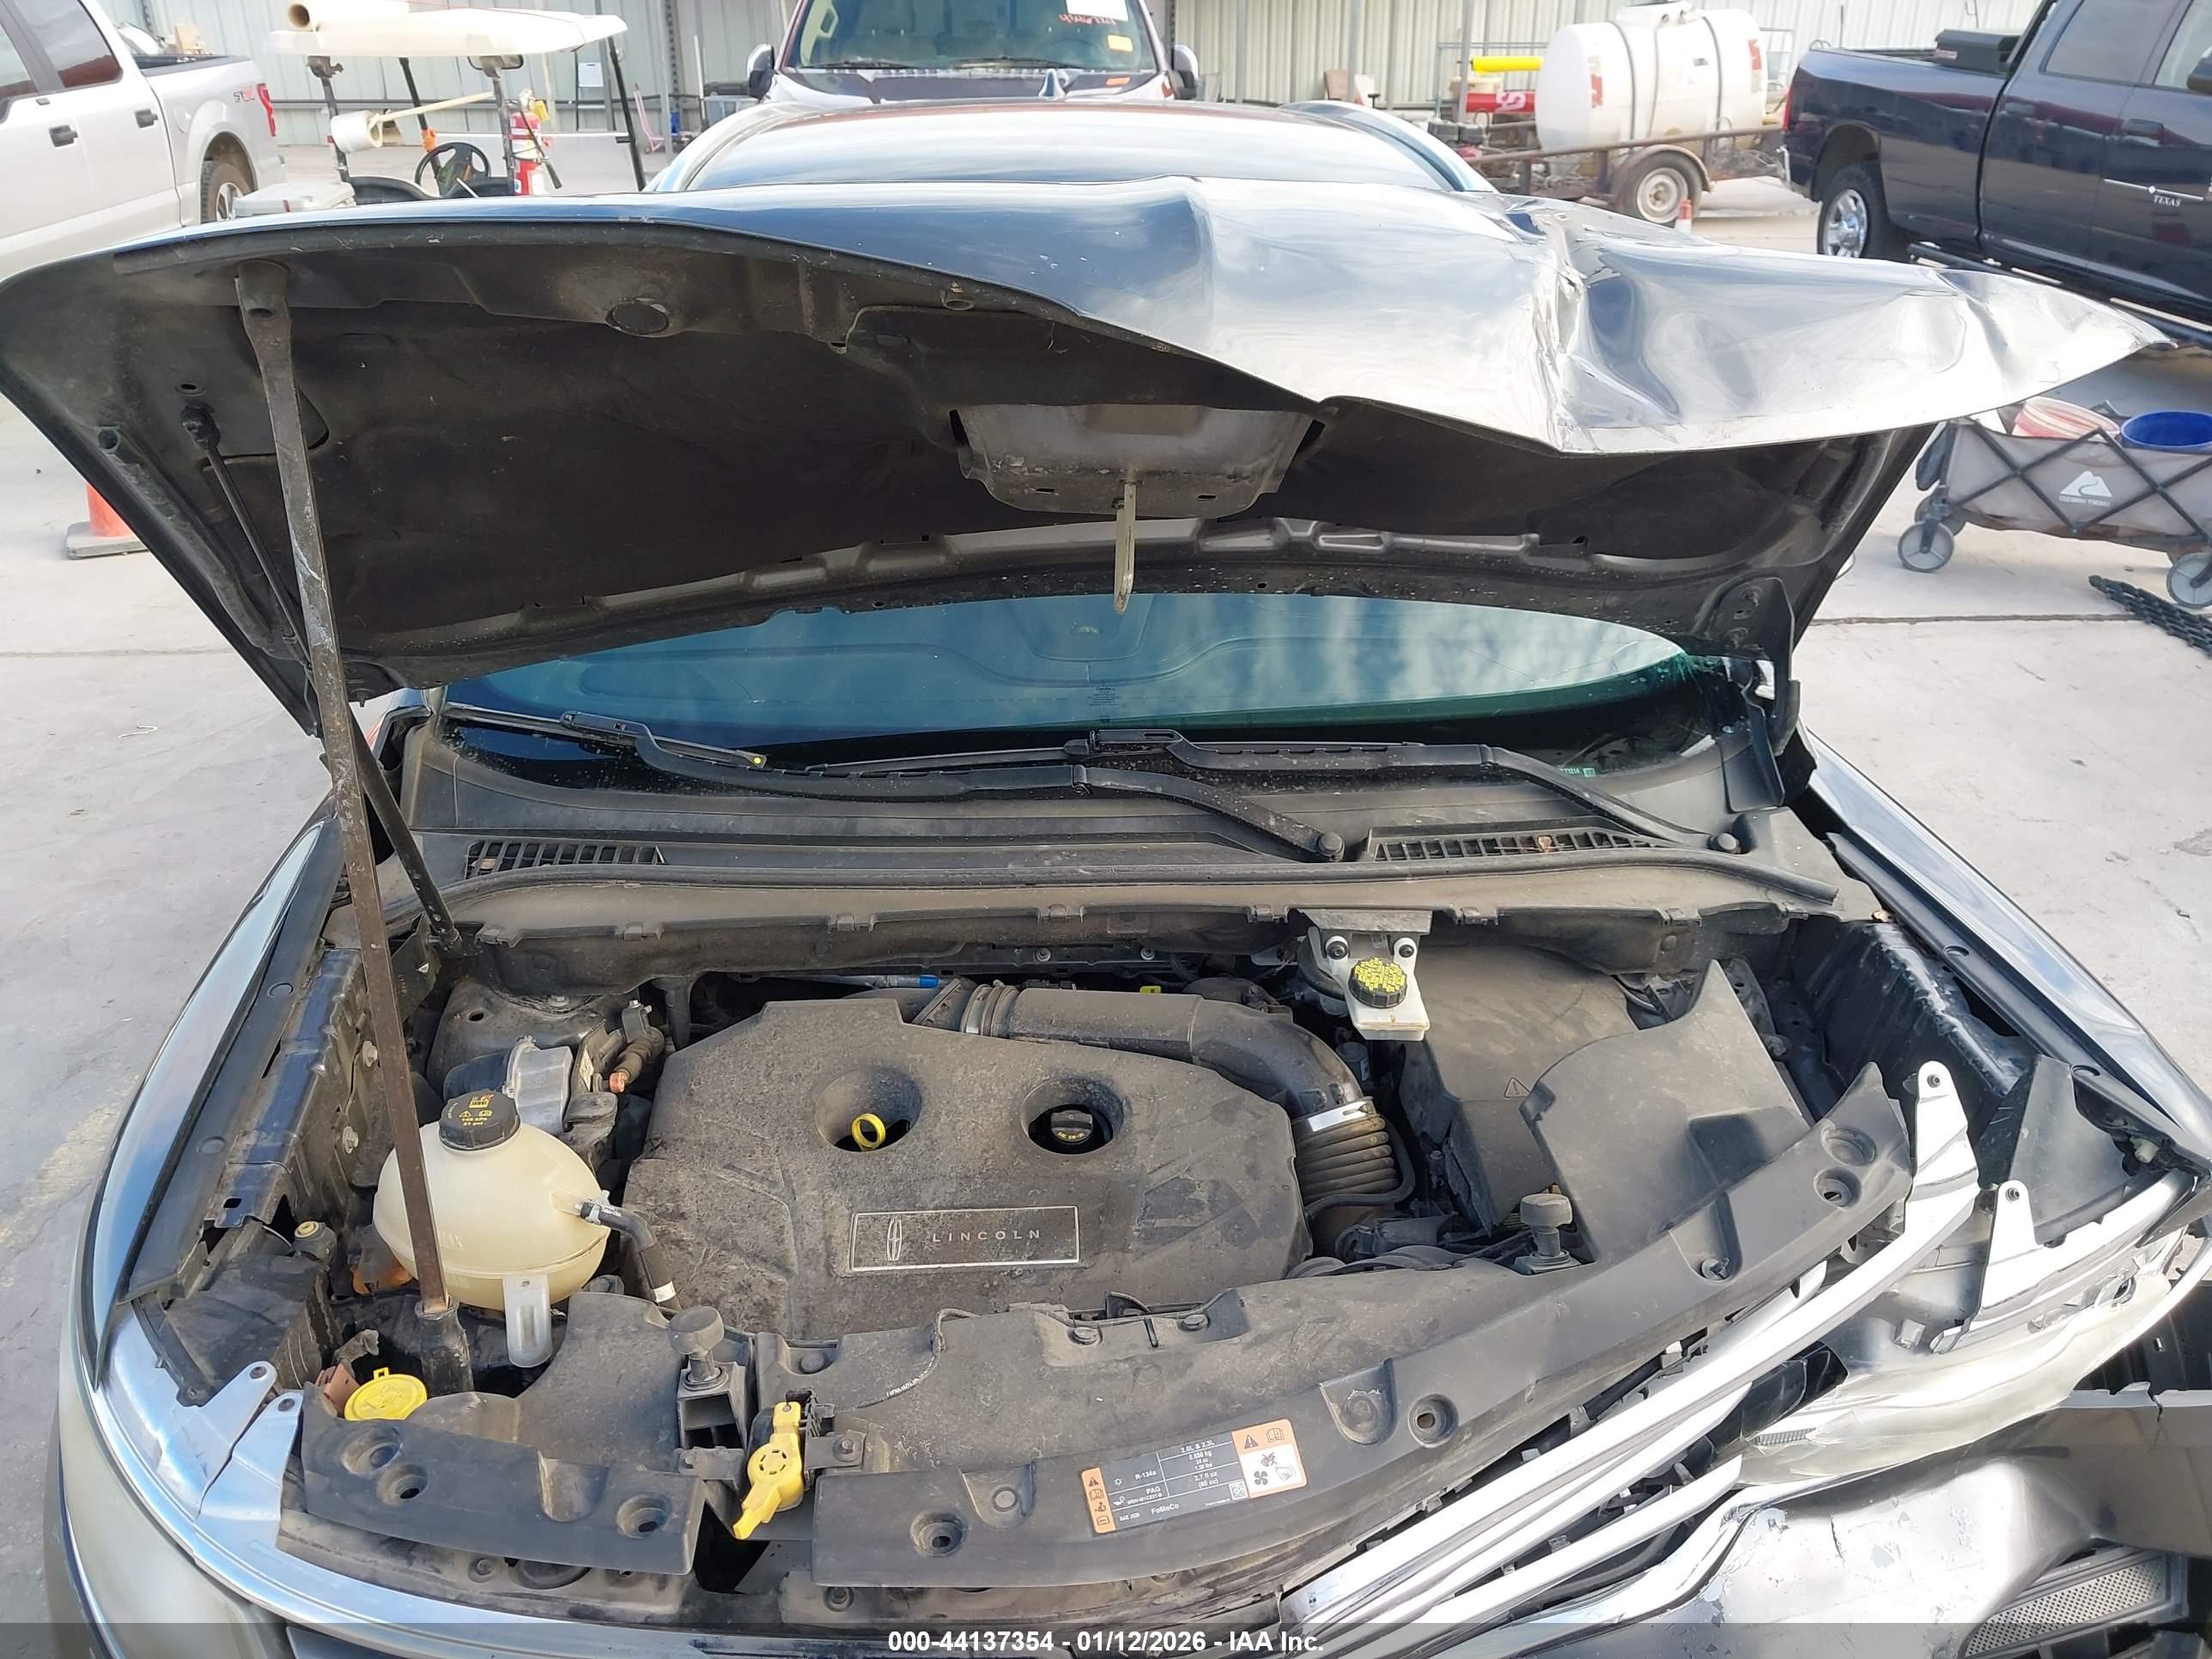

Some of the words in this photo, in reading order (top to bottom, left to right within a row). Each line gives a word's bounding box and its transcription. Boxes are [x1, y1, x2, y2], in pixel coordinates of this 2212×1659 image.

[2152, 194, 2182, 208] TEXAS
[932, 1229, 1041, 1243] LINCOLN
[1134, 1470, 1157, 1480] R-134a
[1146, 1486, 1161, 1495] PAG
[1151, 1504, 1180, 1515] FoMoCo
